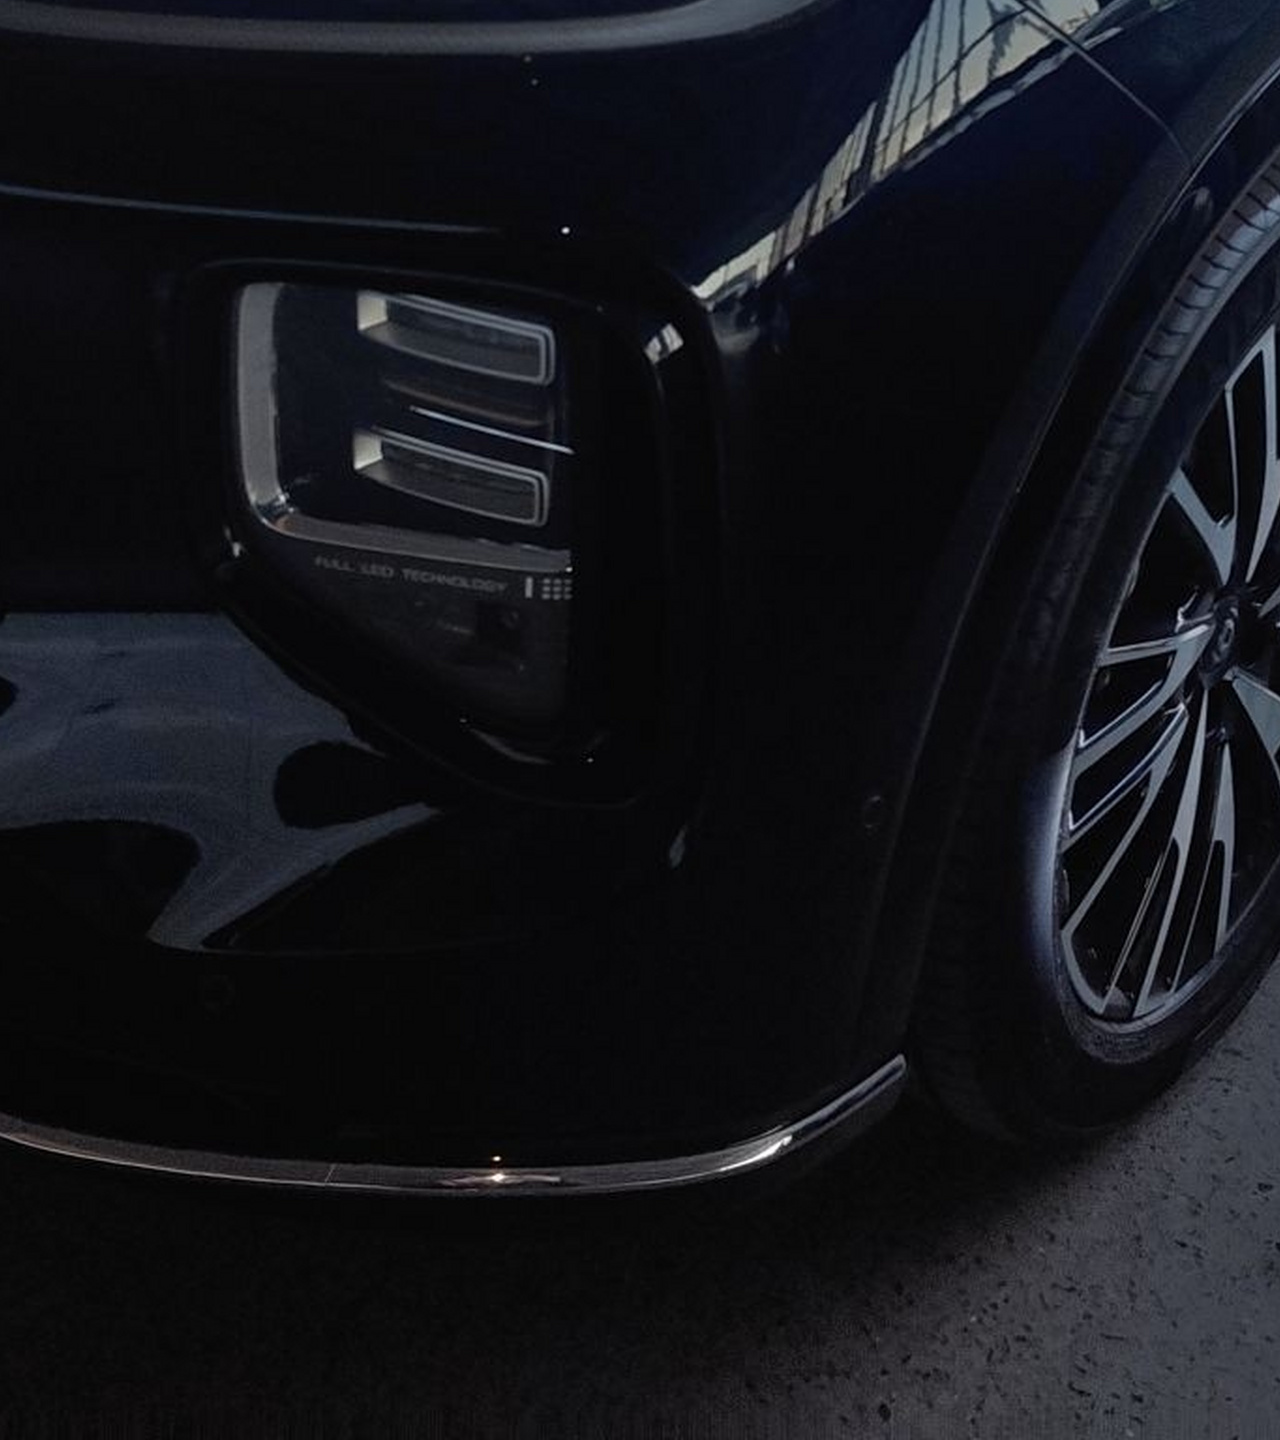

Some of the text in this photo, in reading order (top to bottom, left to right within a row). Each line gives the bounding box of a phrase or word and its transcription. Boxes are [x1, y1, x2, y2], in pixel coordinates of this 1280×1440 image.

[315, 555, 509, 593] FULL LED TECHNOLOGY
